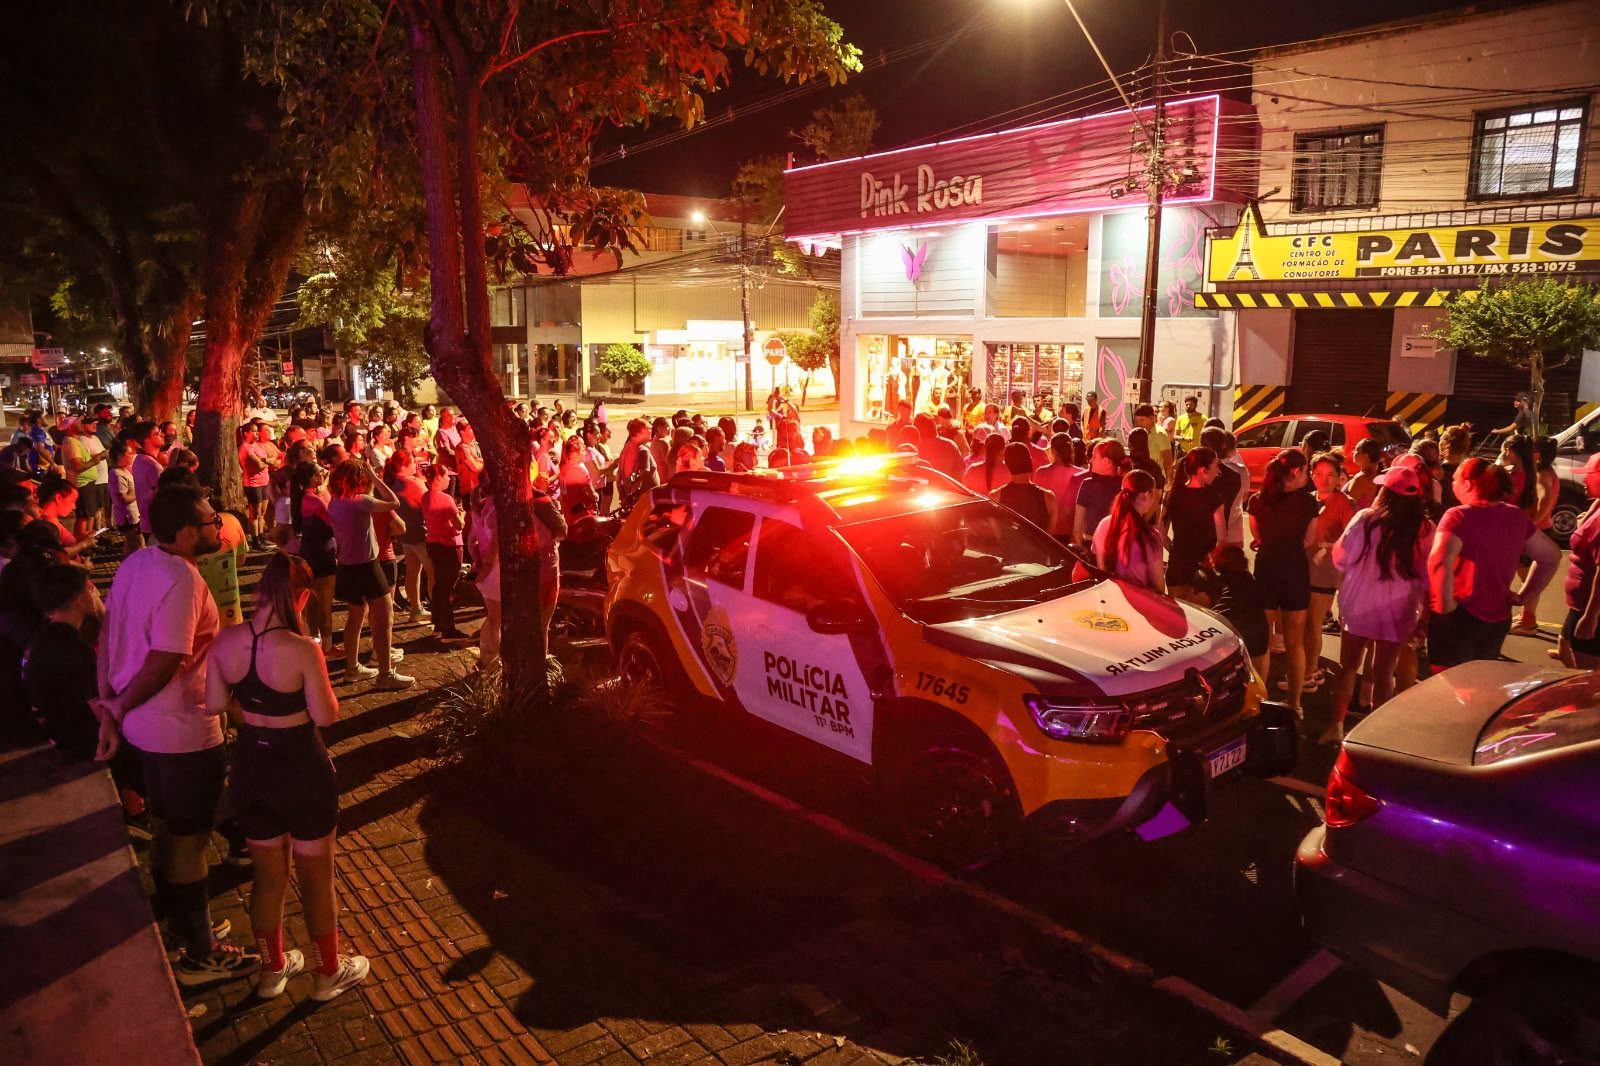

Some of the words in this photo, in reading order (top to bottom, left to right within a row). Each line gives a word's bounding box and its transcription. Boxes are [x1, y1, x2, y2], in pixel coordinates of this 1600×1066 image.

[861, 172, 910, 219] Pink
[917, 163, 983, 213] Rosa
[1292, 235, 1332, 249] CFC
[1356, 224, 1589, 264] PARIS
[1289, 250, 1322, 258] CENTRO
[1325, 249, 1337, 257] DE
[1283, 270, 1341, 278] CONDUTORES
[1380, 267, 1416, 277] FONE:
[1511, 261, 1577, 274] 523-1075
[765, 348, 784, 357] PARE
[916, 671, 970, 705] 17645
[767, 675, 851, 726] MILITAR
[829, 720, 855, 739] BPM
